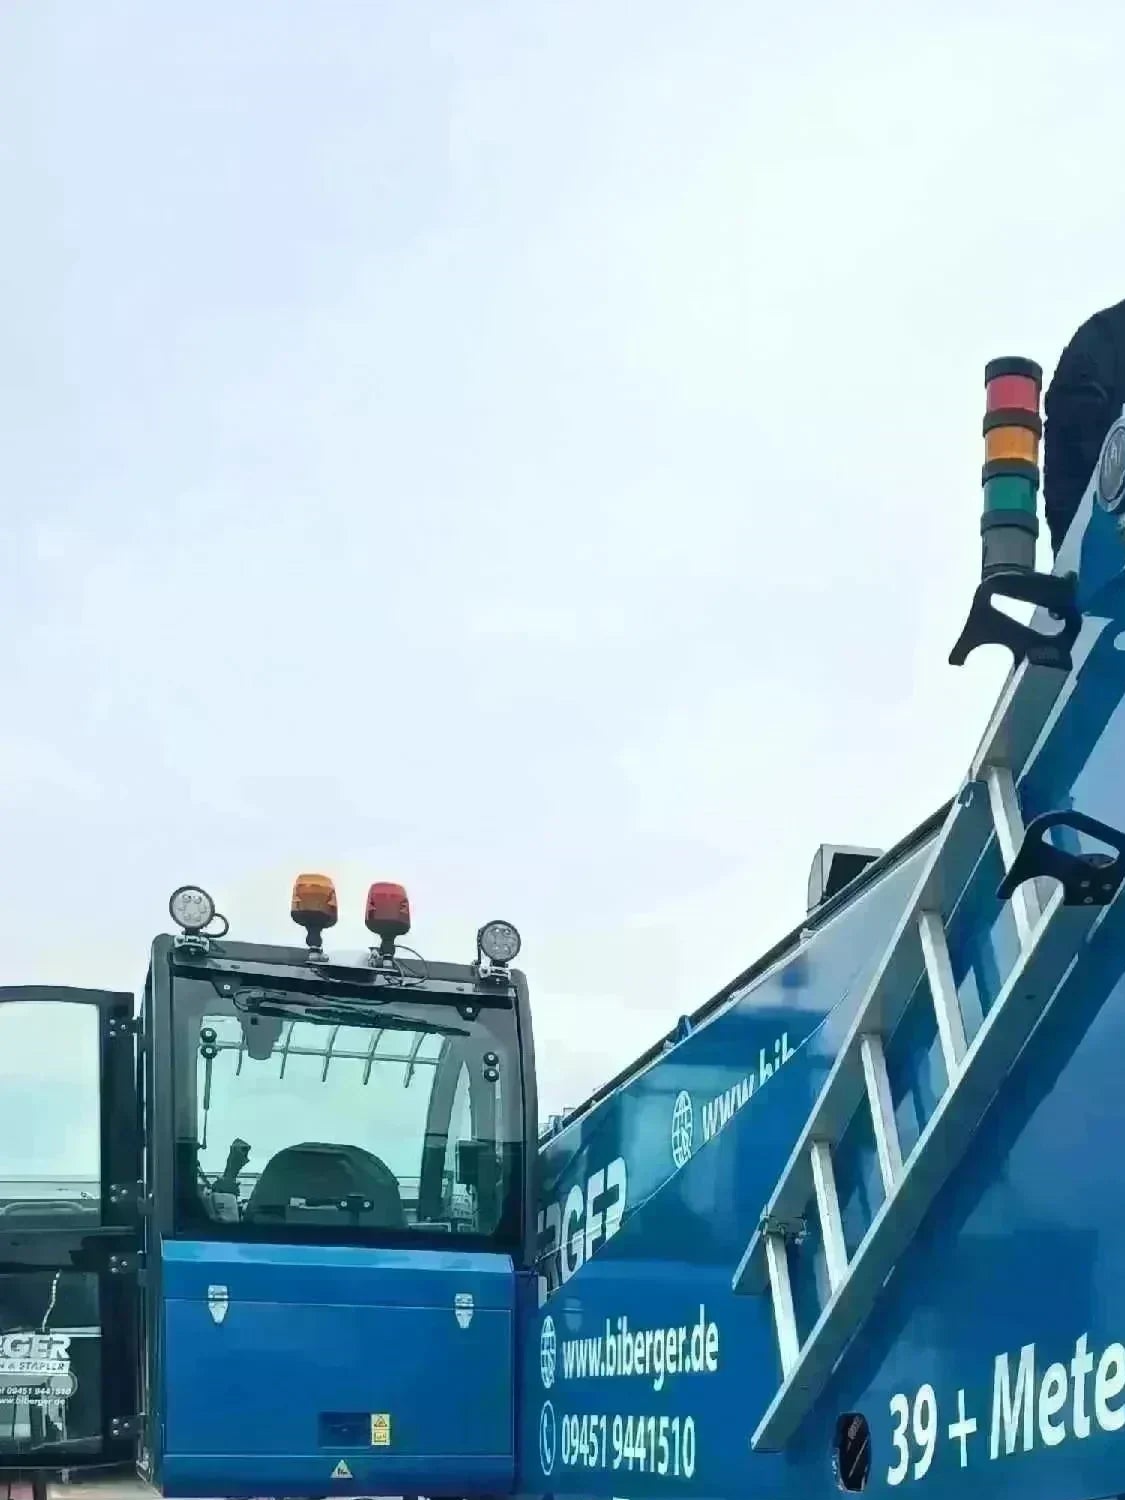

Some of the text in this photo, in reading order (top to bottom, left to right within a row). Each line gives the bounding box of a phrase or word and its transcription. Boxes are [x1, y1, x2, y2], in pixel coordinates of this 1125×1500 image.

[0, 1333, 71, 1359] GER
[562, 1303, 719, 1391] www.biberger.de
[561, 1414, 696, 1479] 09451 9441510
[886, 1383, 938, 1486] 39
[947, 1388, 977, 1468] +
